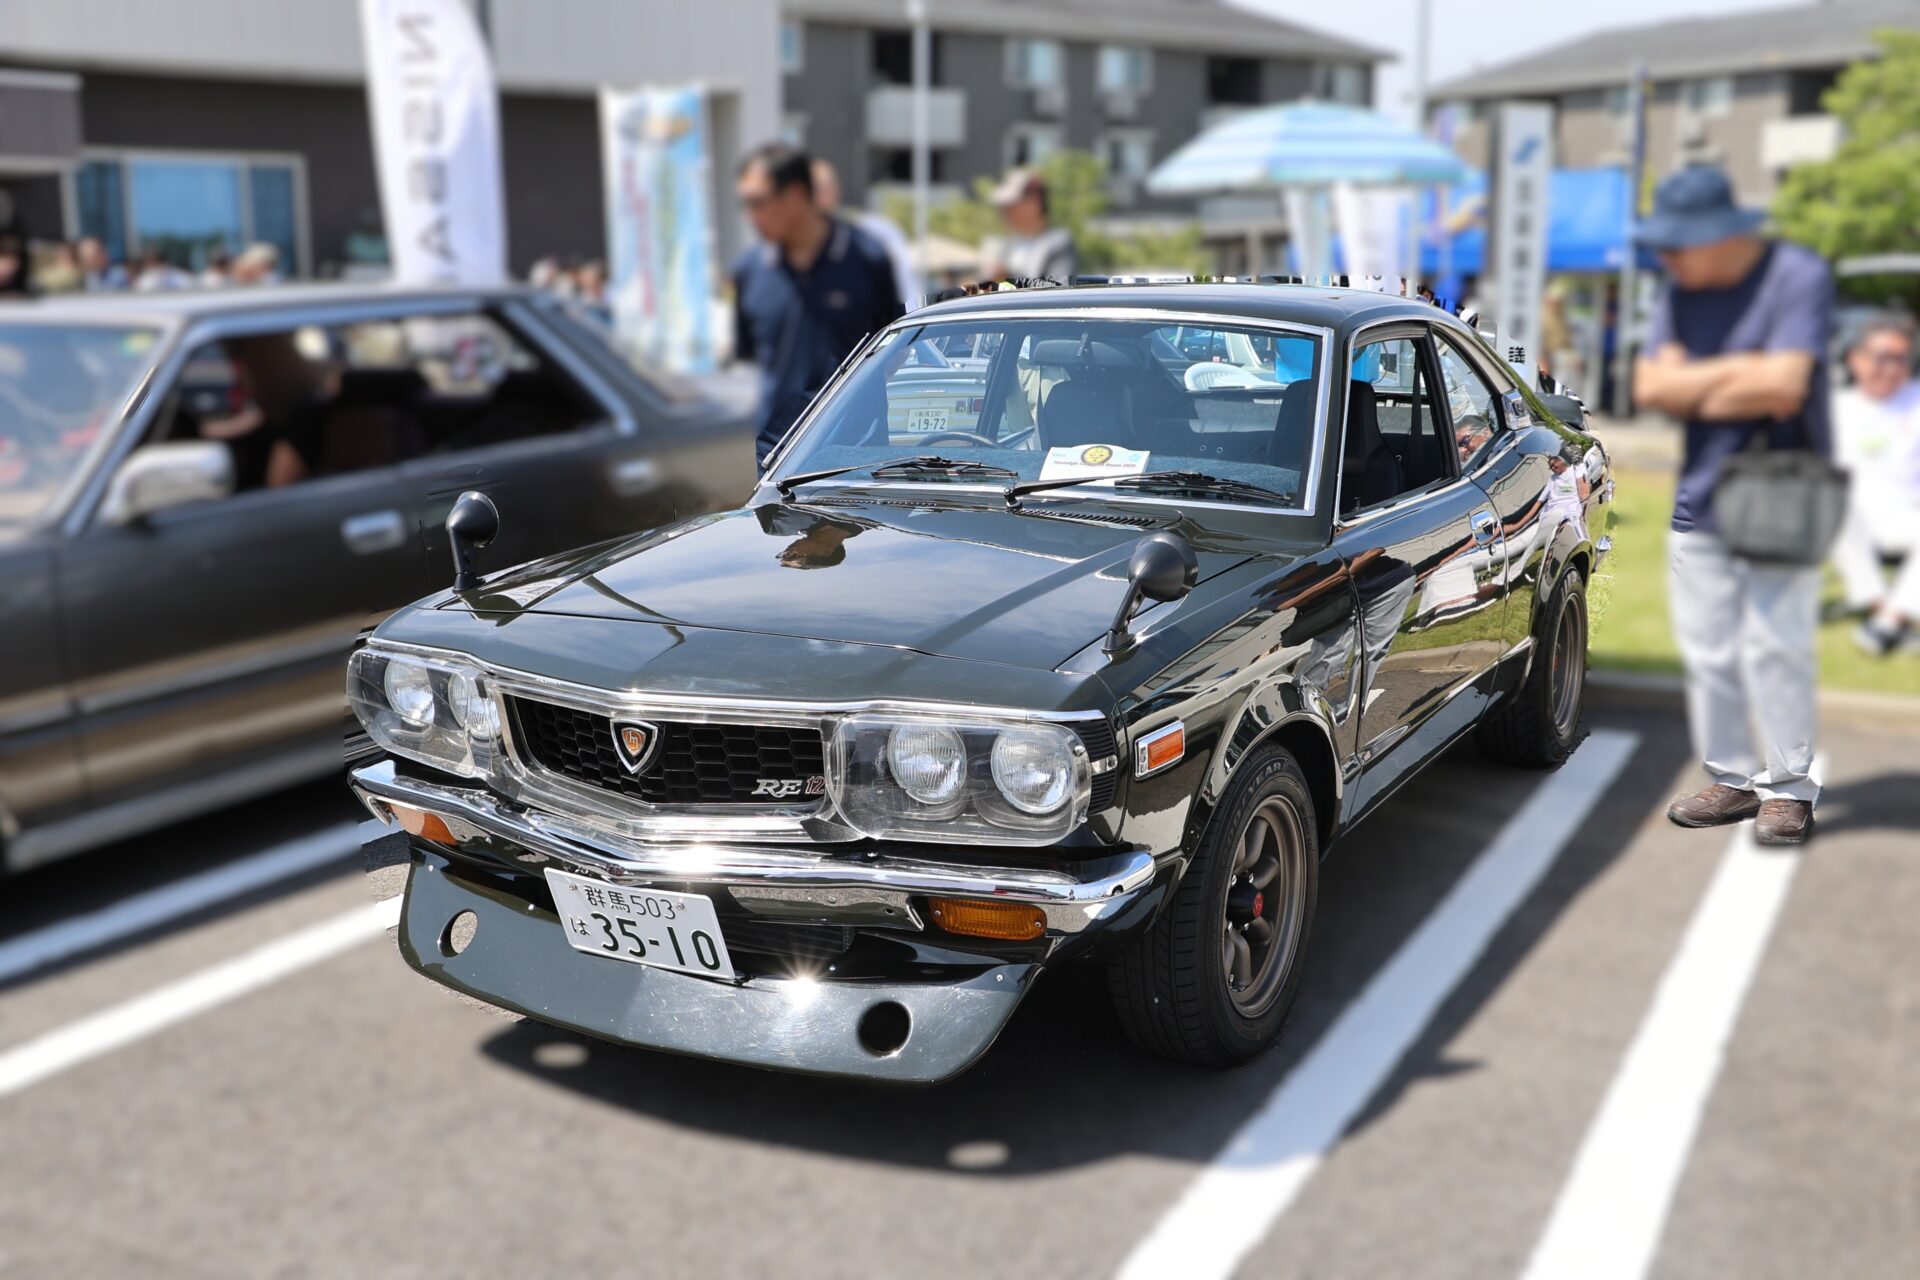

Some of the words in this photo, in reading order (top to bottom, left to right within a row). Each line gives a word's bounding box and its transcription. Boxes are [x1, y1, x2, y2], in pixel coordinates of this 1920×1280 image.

[918, 418, 946, 430] 19-72
[570, 916, 591, 937] は
[591, 912, 721, 971] 35-10
